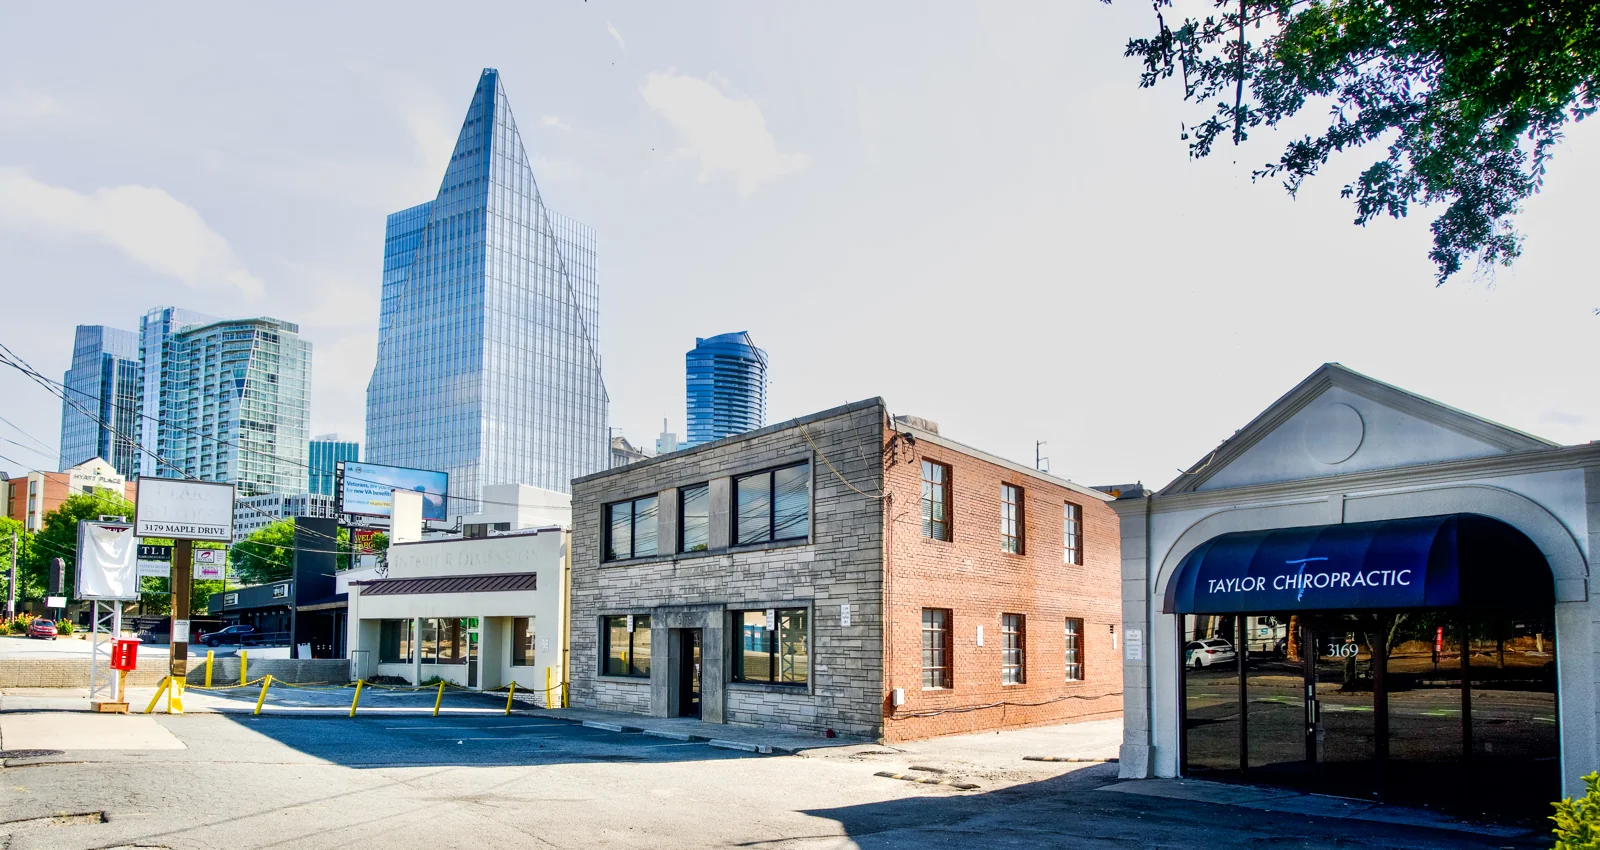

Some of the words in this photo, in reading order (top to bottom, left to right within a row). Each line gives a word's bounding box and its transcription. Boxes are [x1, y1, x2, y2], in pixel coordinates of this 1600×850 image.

[166, 525, 196, 534] MAPLE
[198, 526, 225, 535] DRIVE
[1208, 576, 1266, 593] TAYLOR
[1273, 569, 1412, 589] CHIROPRACTIC
[1326, 643, 1359, 658] 3169
